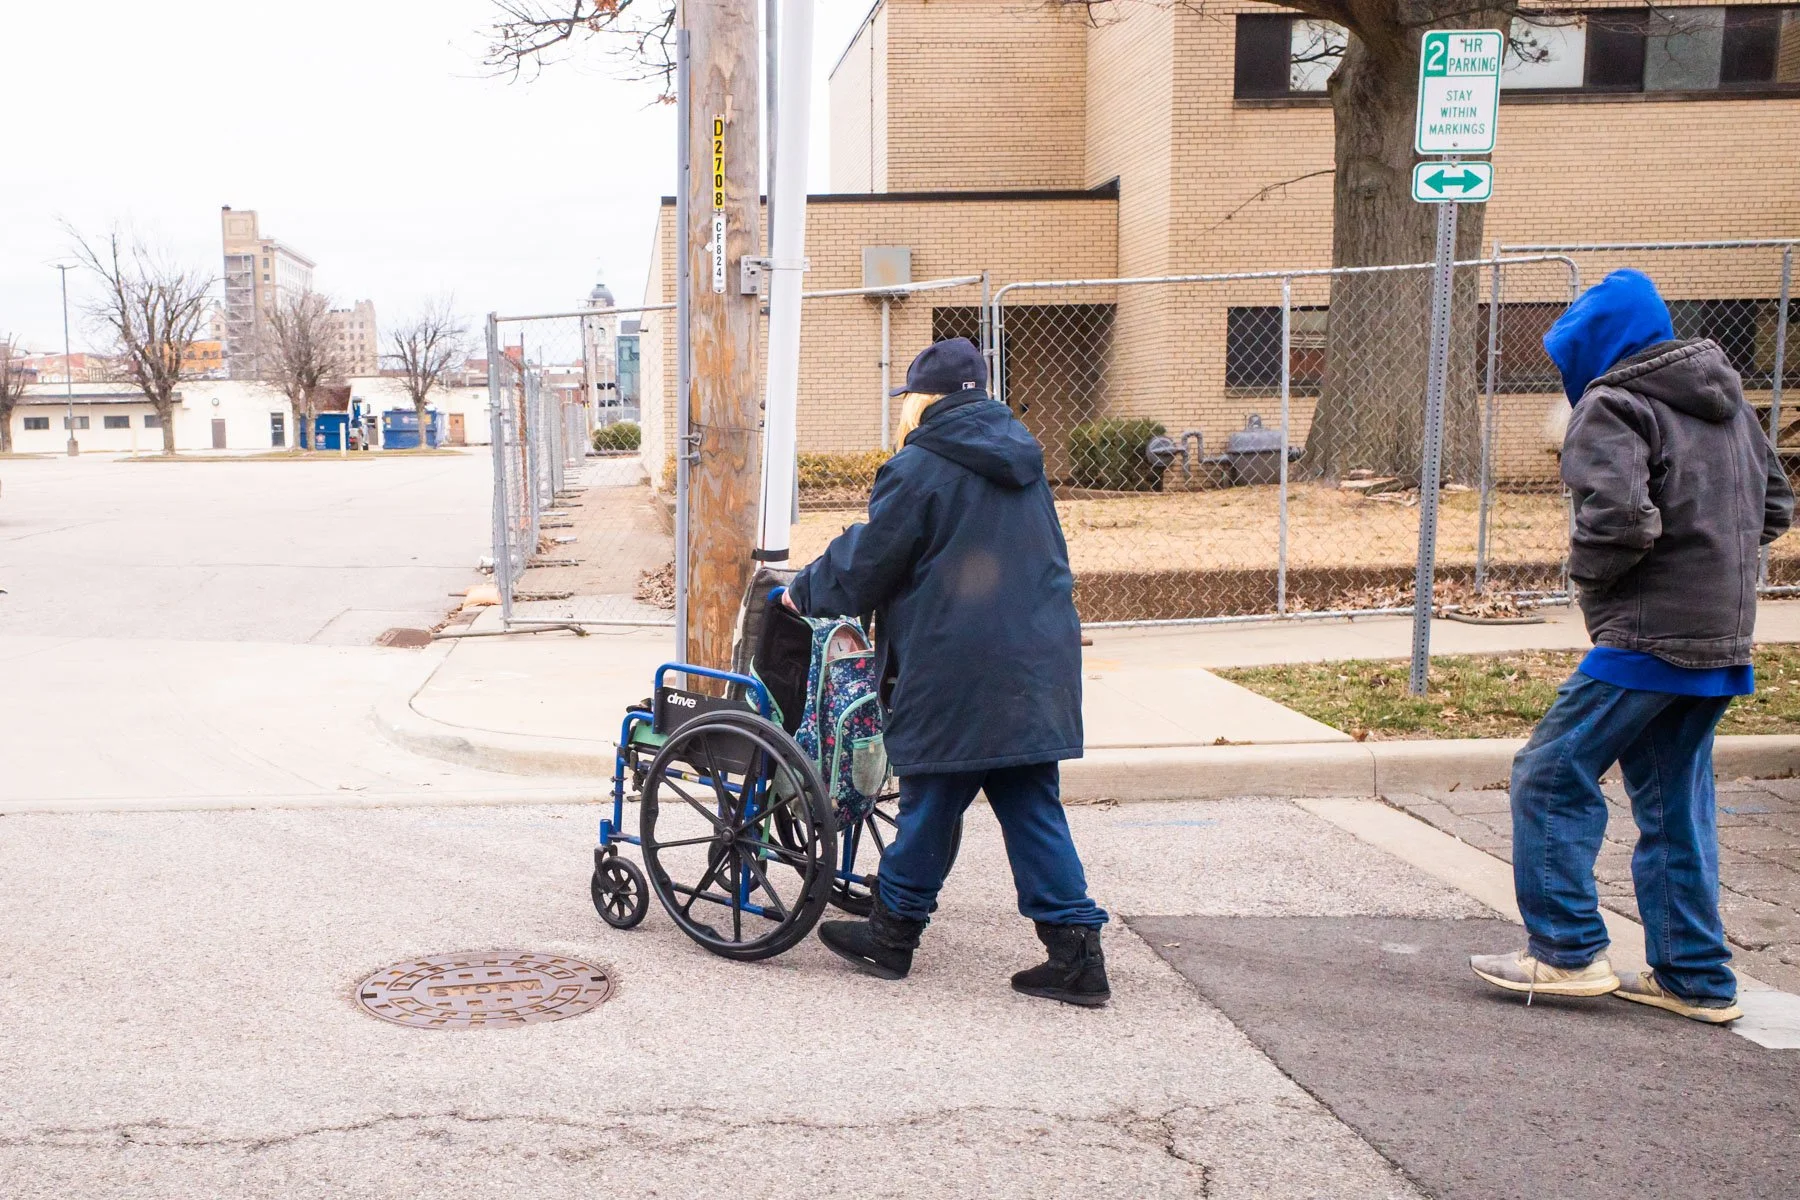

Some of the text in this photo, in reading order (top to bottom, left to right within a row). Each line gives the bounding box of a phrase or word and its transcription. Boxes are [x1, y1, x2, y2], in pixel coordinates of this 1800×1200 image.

[1427, 38, 1483, 71] 2 HR
[1448, 57, 1496, 72] PARKING
[1446, 90, 1473, 101] STAY
[1440, 107, 1477, 118] WITHIN
[1429, 123, 1485, 135] MARKINGS
[713, 119, 724, 206] D2708
[667, 692, 697, 708] drive
[433, 982, 544, 997] STORM
